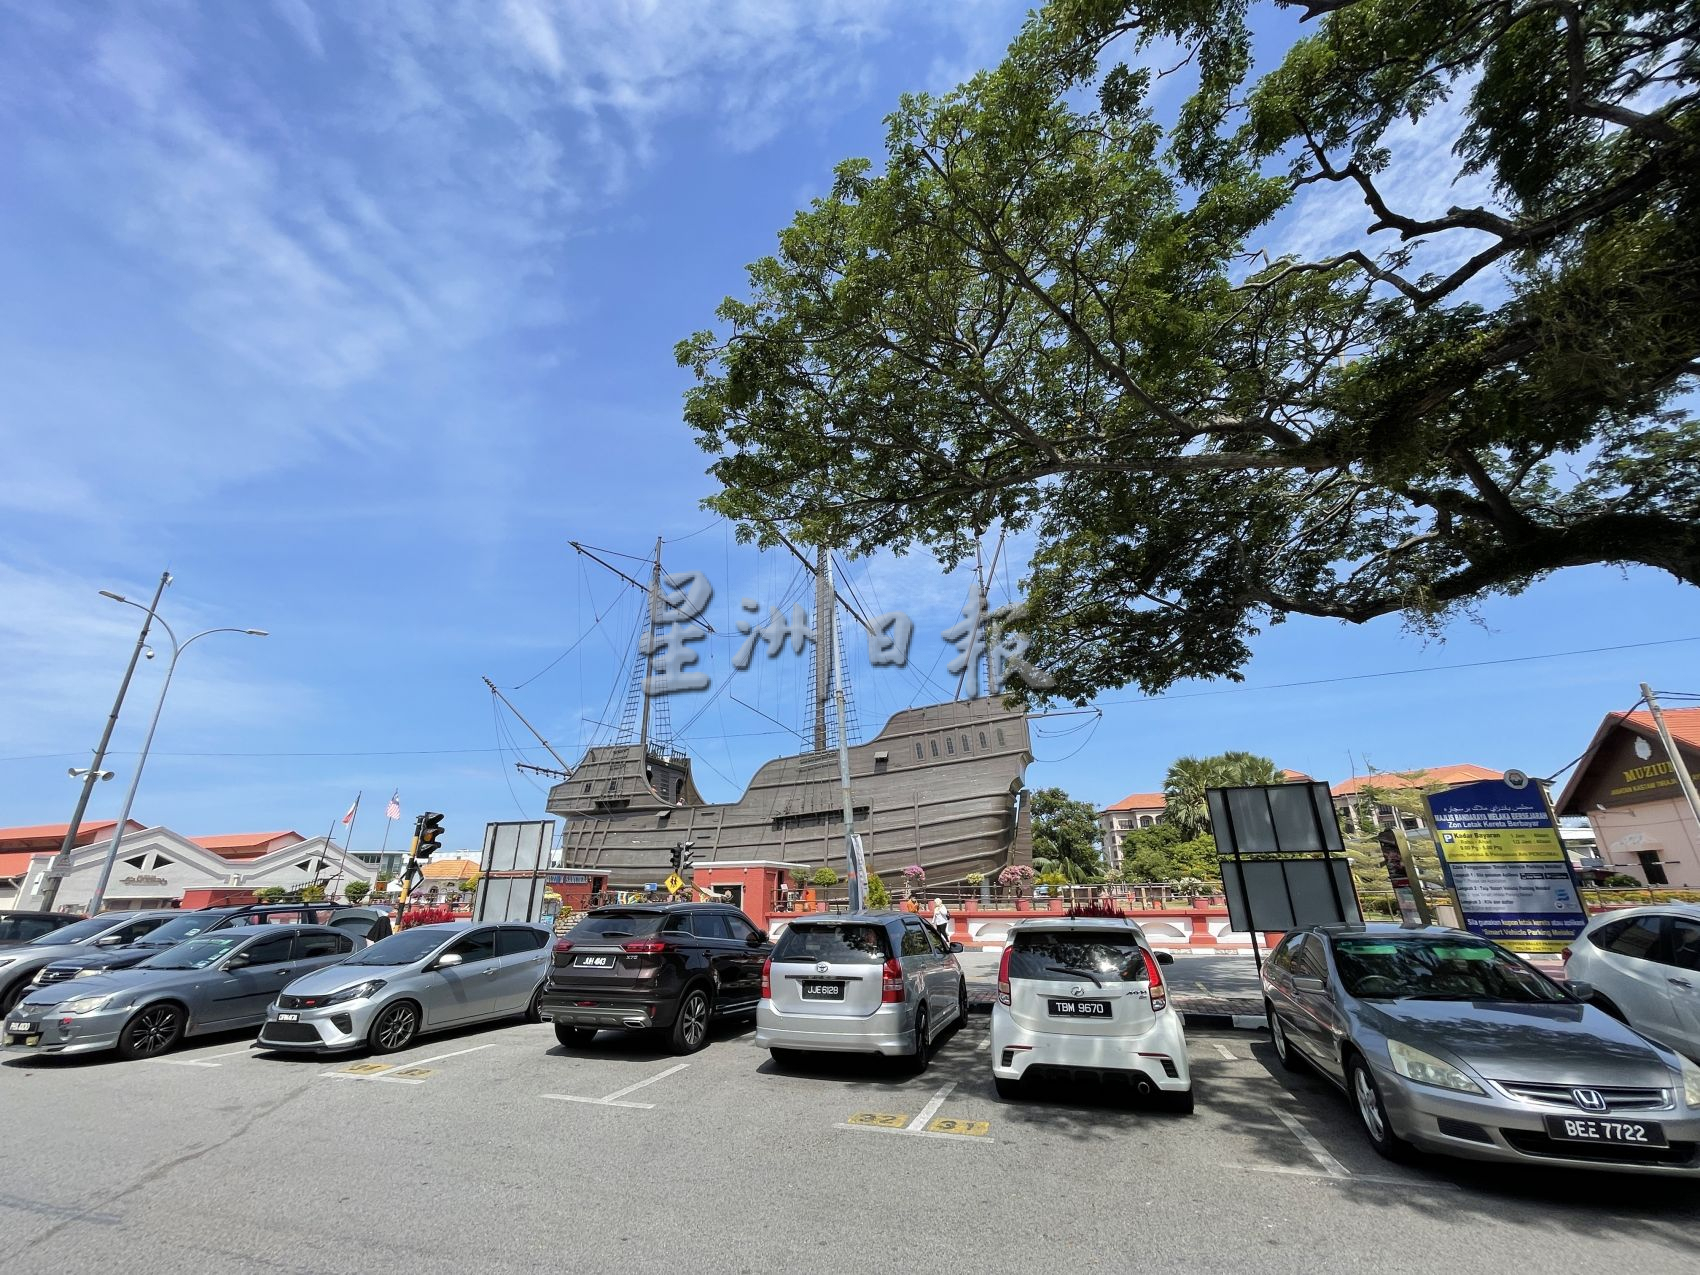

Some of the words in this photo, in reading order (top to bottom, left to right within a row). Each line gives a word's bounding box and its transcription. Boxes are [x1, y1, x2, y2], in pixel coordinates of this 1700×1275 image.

[1434, 814, 1454, 822] MAJLIS
[1487, 813, 1511, 821] MELAKA
[1482, 820, 1507, 828] Kereta
[1507, 820, 1539, 828] Berbayar
[1443, 834, 1452, 843] P
[1473, 832, 1501, 840] Bayaran
[1467, 918, 1478, 926] Sila
[1527, 928, 1552, 938] Parking
[1056, 1002, 1075, 1013] TBM
[1078, 1003, 1104, 1014] 9670
[1564, 1119, 1600, 1138] BEE
[1600, 1121, 1649, 1142] 7722
